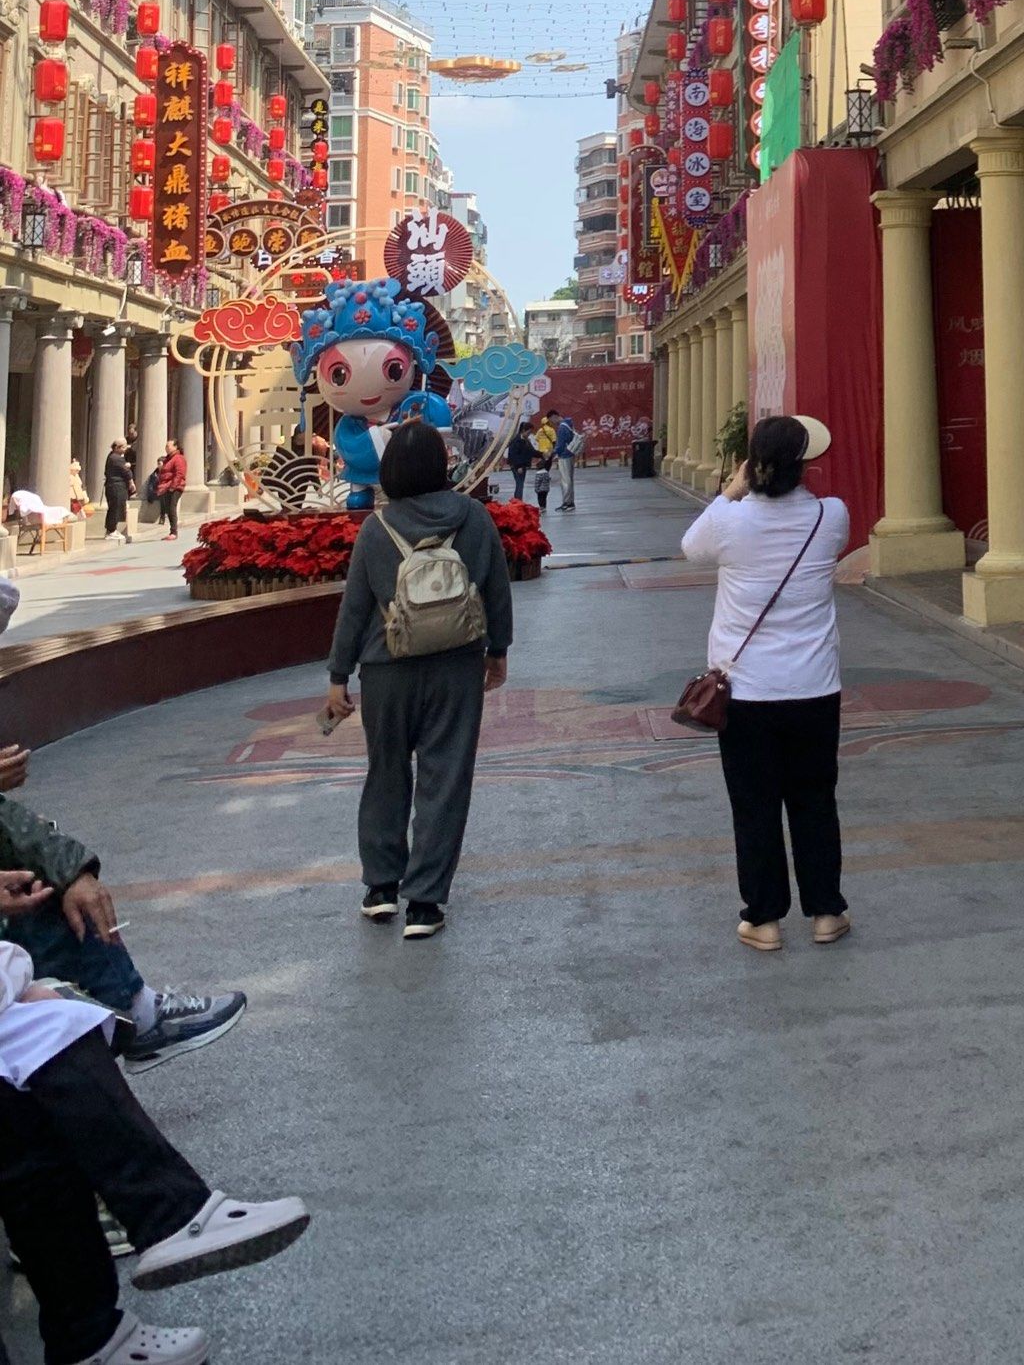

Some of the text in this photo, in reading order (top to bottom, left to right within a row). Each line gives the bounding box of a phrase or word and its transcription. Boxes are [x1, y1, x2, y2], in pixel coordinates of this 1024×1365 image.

[687, 85, 706, 208] 南海冰室
[407, 206, 449, 296] 汕頭
